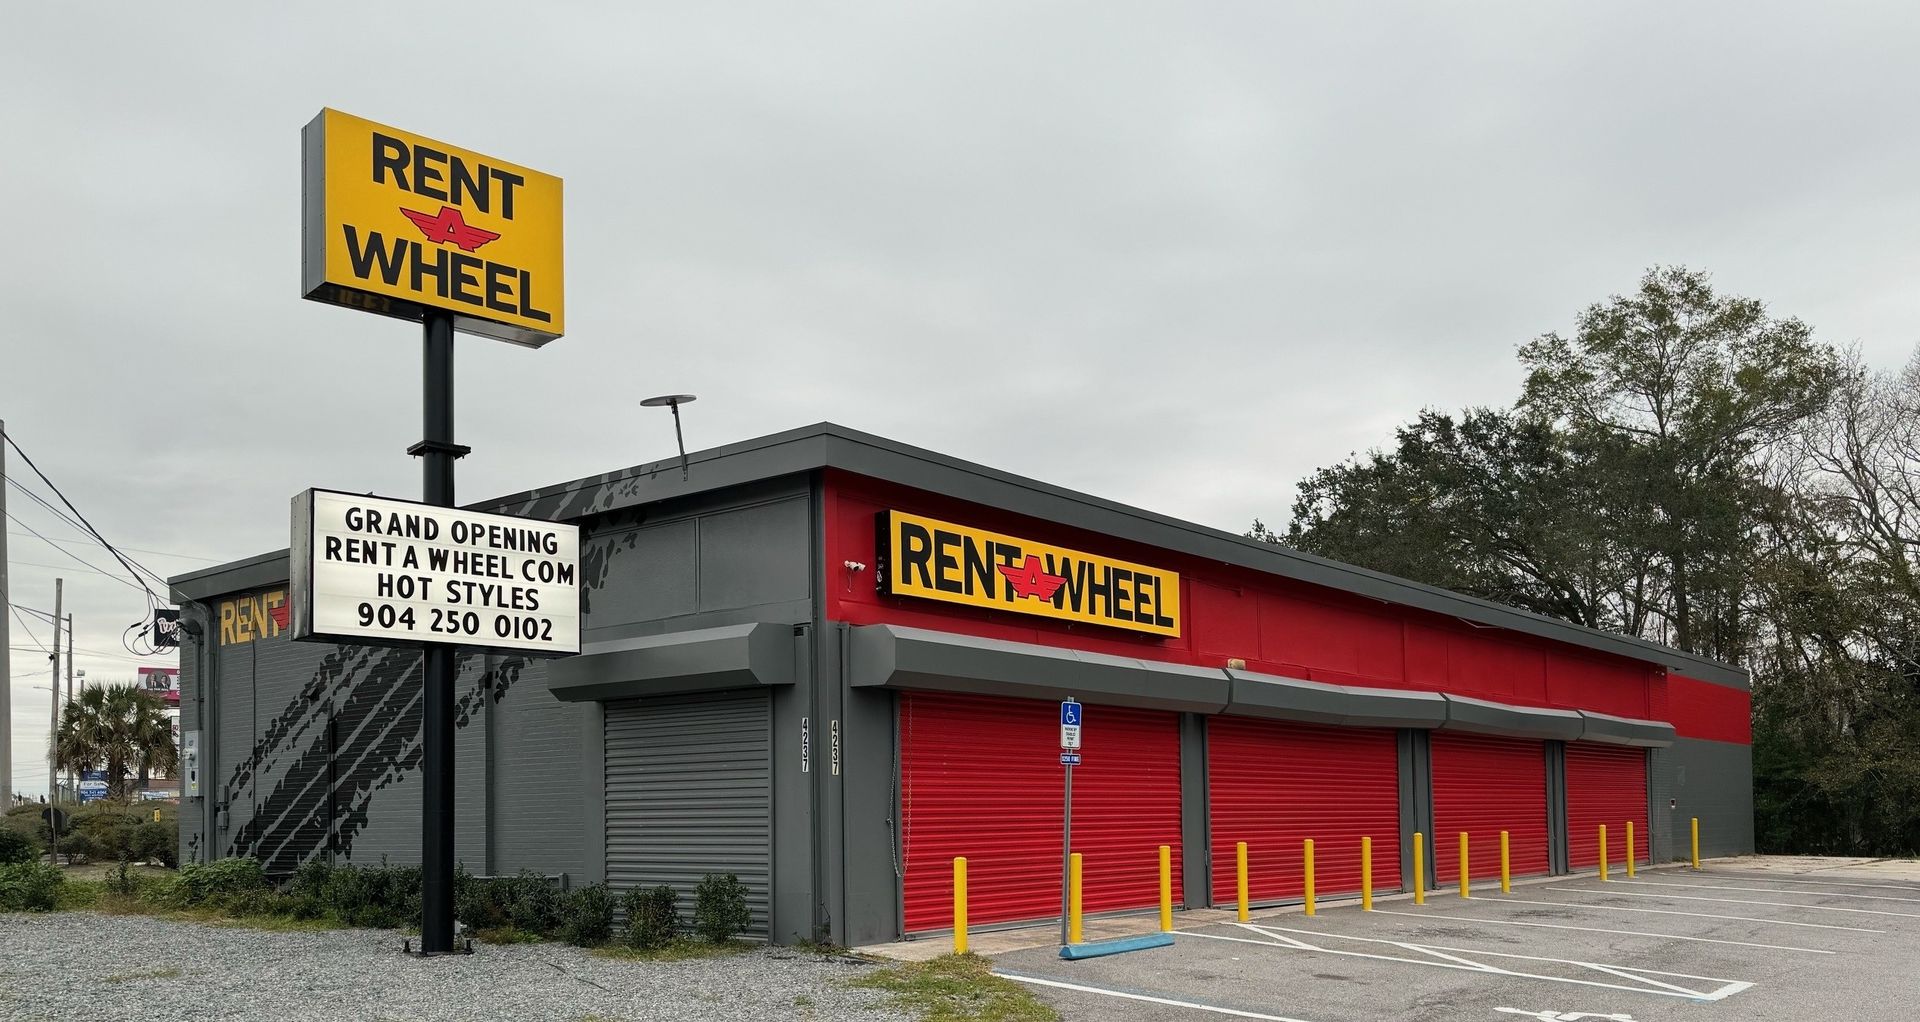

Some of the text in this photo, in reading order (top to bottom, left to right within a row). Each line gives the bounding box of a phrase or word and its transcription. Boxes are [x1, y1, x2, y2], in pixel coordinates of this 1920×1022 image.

[372, 132, 524, 220] RENT
[342, 223, 551, 323] WHEEL
[345, 507, 558, 555] GRAND OPENING
[325, 535, 574, 586] RENT A WHEEL COM
[900, 521, 1022, 603] RENT
[1045, 553, 1174, 628] WHEEL
[221, 590, 284, 647] RENT
[377, 572, 539, 611] HOT STYLES
[358, 602, 553, 642] 904 250 0102
